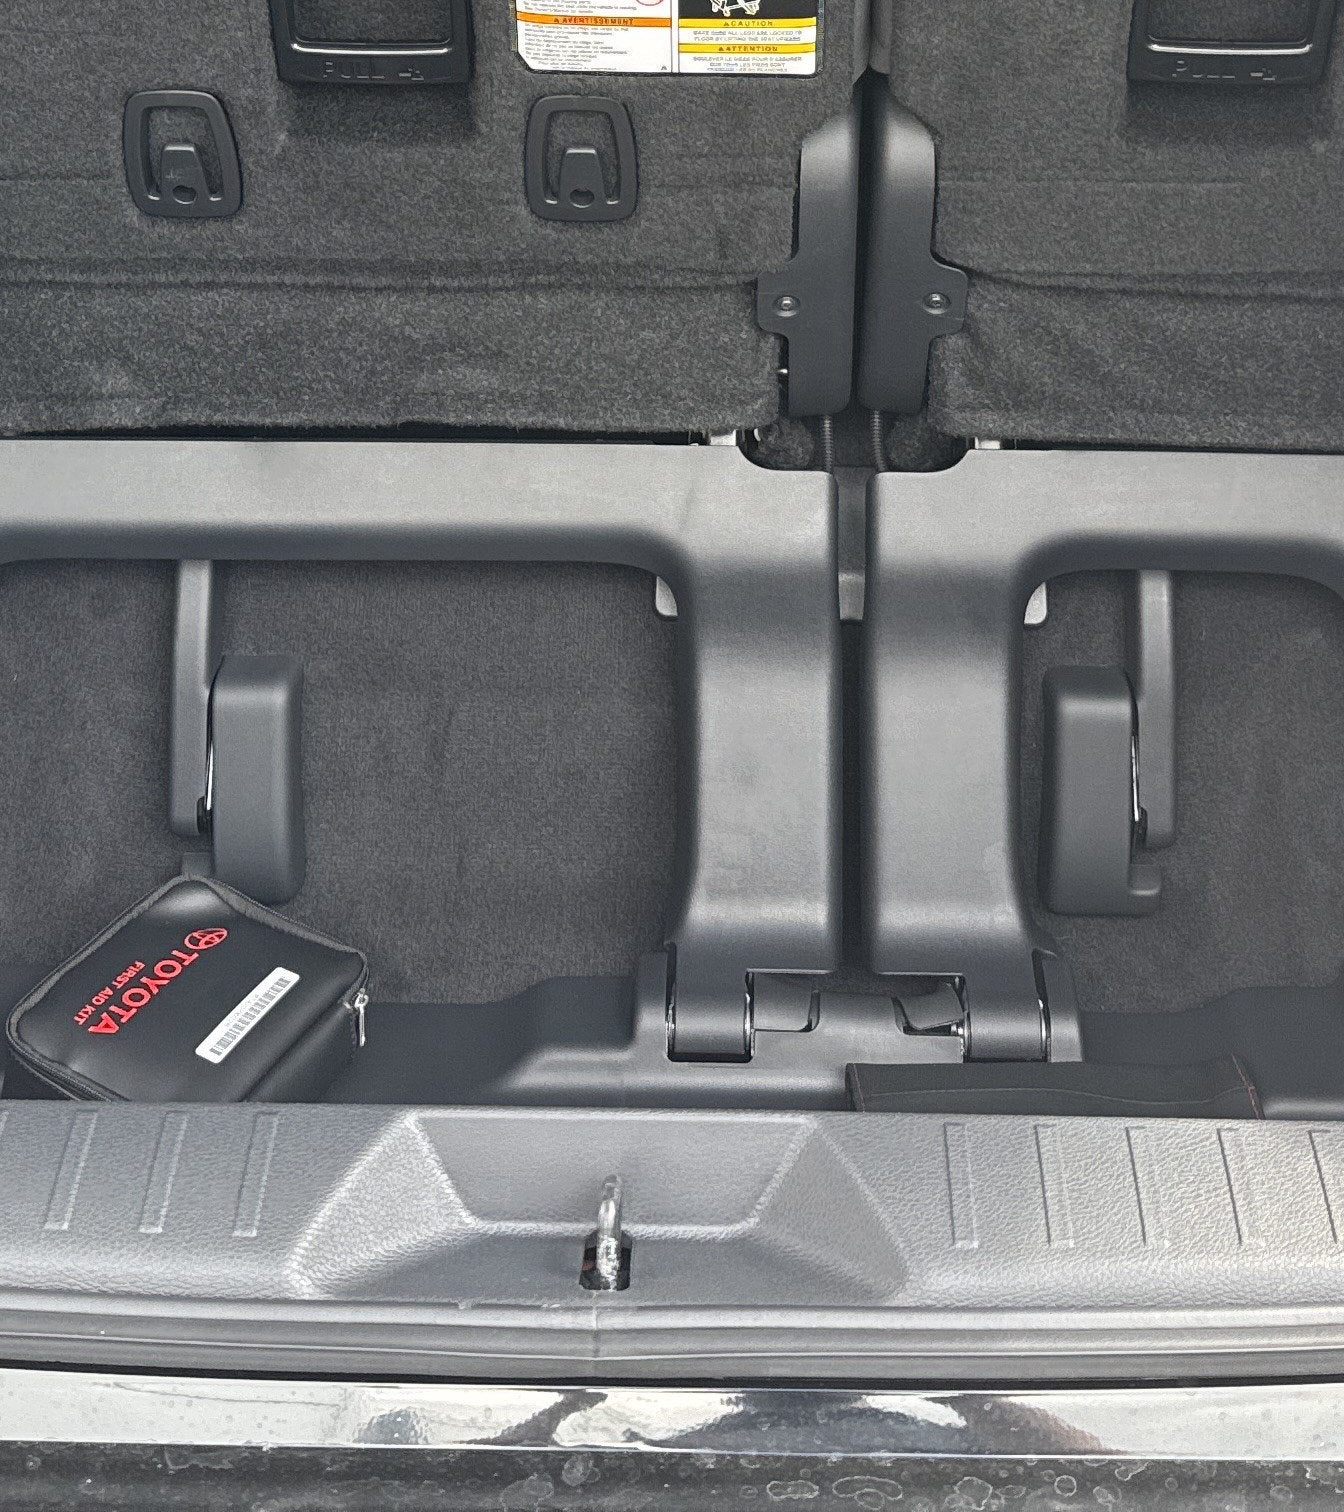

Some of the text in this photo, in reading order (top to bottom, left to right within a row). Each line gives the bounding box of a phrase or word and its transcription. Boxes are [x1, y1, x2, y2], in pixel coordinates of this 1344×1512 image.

[73, 960, 146, 1026] FIRST AID KIT
[87, 949, 200, 1035] TOYOTA
